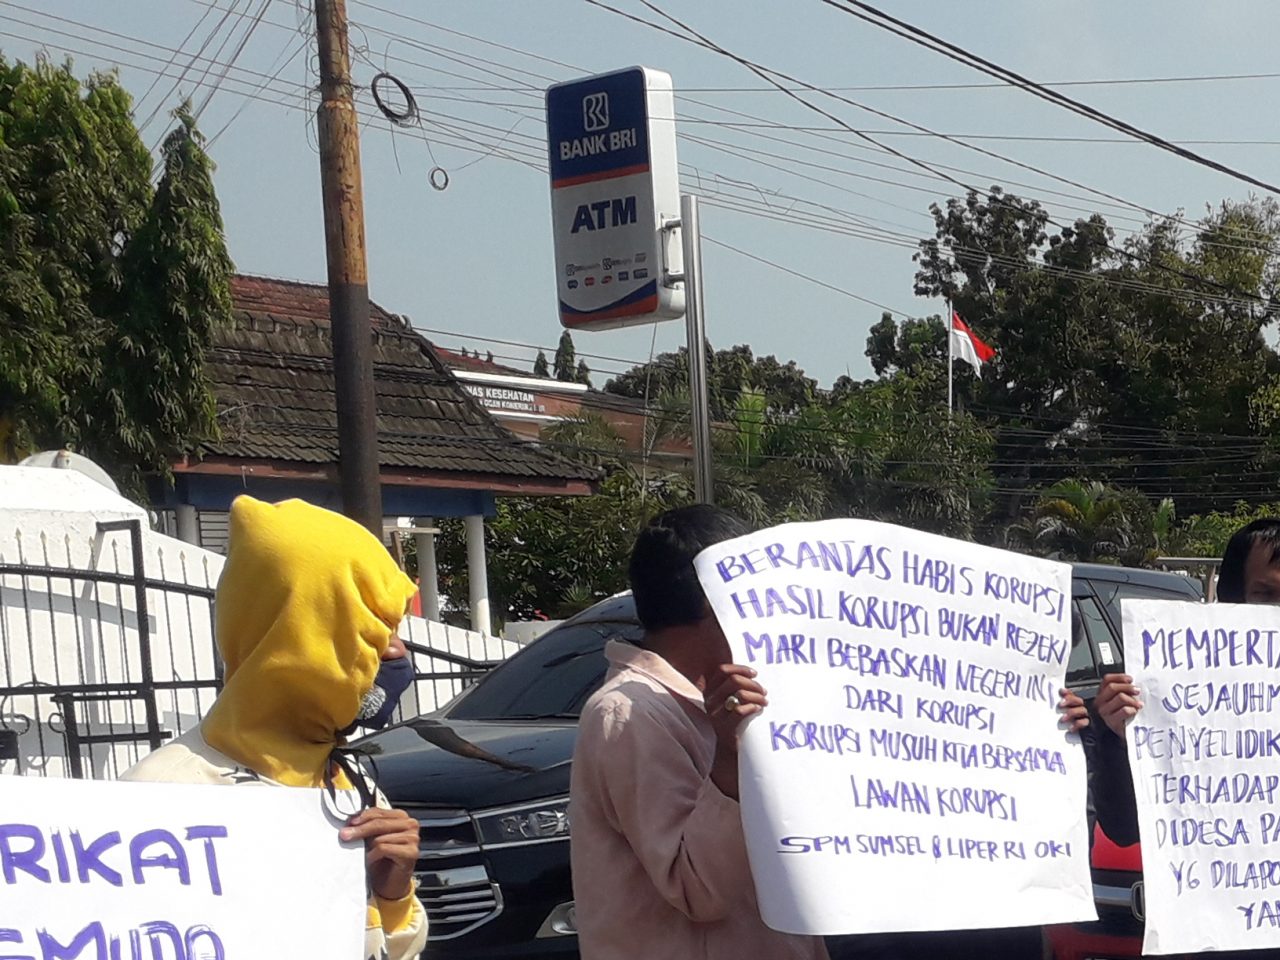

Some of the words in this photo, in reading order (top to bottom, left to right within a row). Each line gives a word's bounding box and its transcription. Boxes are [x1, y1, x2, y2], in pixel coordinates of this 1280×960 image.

[560, 136, 606, 161] BANK
[610, 129, 636, 150] BRI
[571, 196, 637, 234] ATM
[487, 388, 534, 402] KESEHATAN
[715, 540, 891, 583] BERANTAS
[903, 550, 973, 596] HABIS
[983, 571, 1065, 622] KORUPSI
[730, 585, 833, 620] HASIL
[838, 590, 928, 637] KORUPSI
[938, 608, 999, 646] BUKAN
[742, 631, 816, 664] MARI
[827, 638, 946, 690] BEBASKAN
[843, 685, 903, 718] DARI
[917, 698, 994, 733] KORUPSI
[769, 720, 860, 755] KORUPSI
[870, 728, 937, 762] MUSUH
[982, 743, 1067, 775] BERSAMA
[850, 775, 931, 815] LAWAN
[936, 786, 1017, 821] KORUPSI
[1151, 773, 1279, 805] TERHADAP
[0, 824, 228, 895] RIKAT
[777, 835, 851, 855] SPM
[856, 834, 926, 857] SUMSEL
[1035, 840, 1071, 859] OKI
